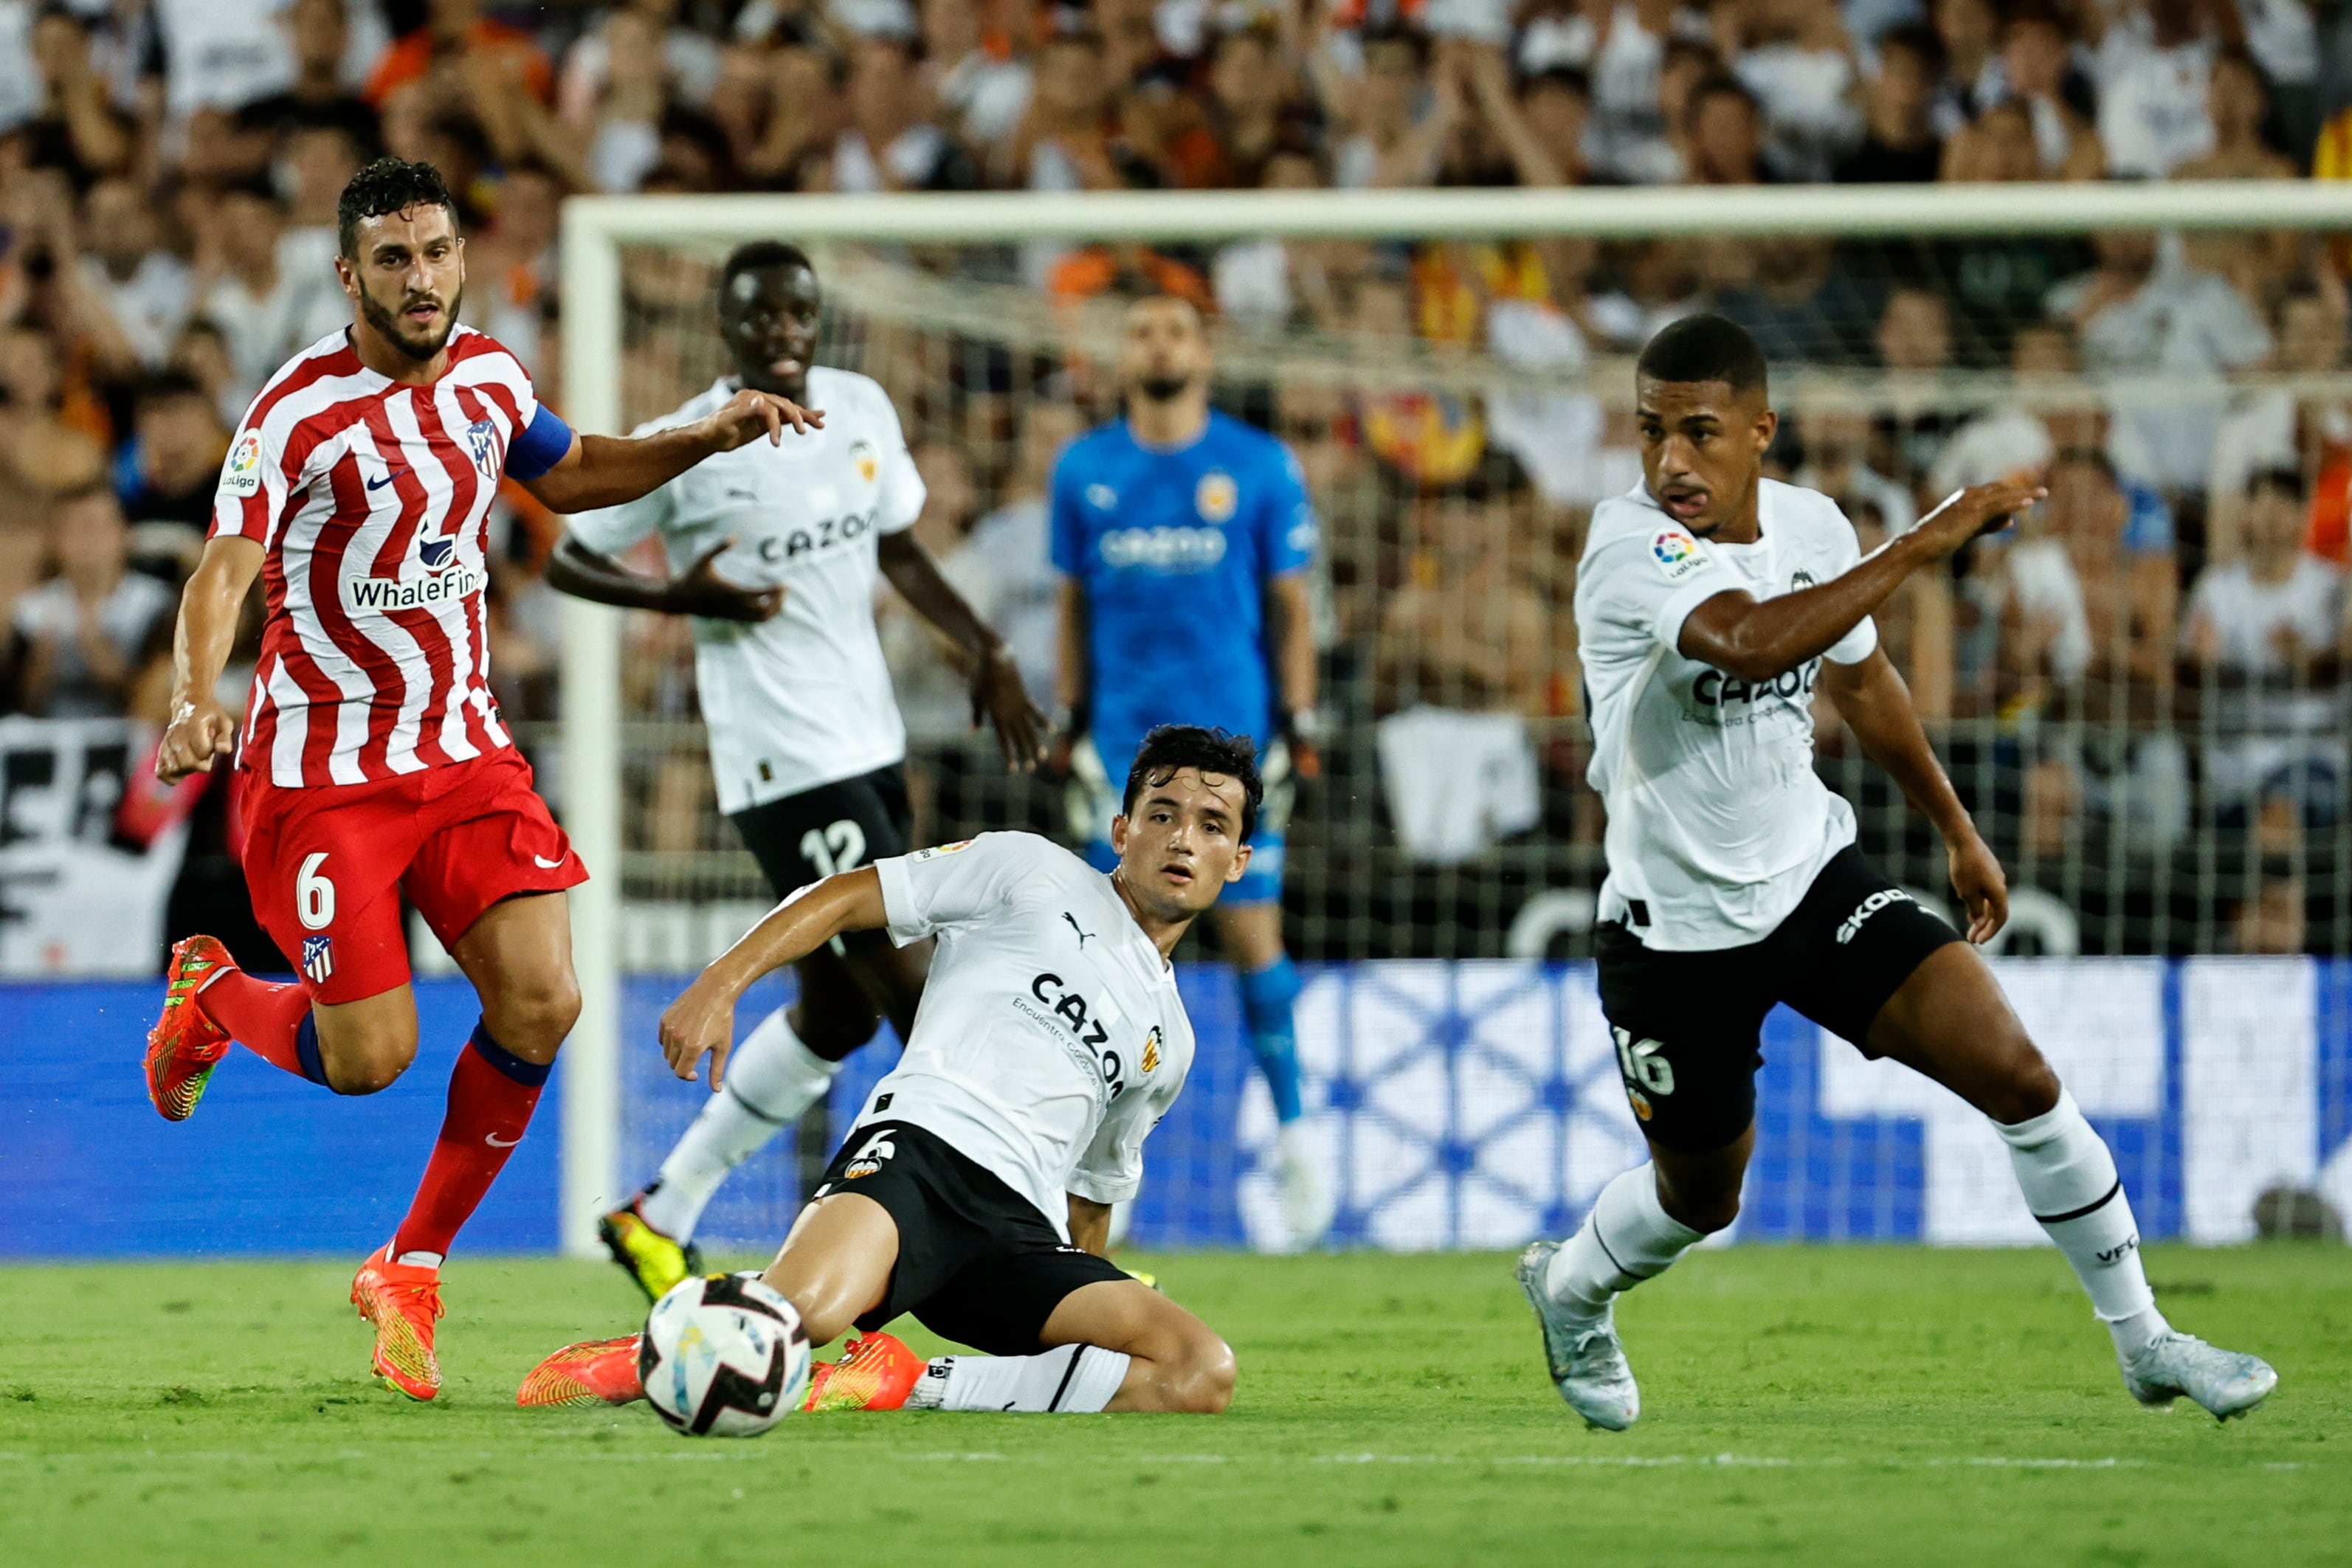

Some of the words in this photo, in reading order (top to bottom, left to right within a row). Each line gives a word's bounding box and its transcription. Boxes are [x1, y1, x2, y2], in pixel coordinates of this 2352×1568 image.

[223, 474, 255, 488] LaLiga
[296, 852, 336, 931] 6
[799, 819, 866, 957] 12
[1835, 888, 1914, 945] SKOD
[1612, 1025, 1675, 1096] 16
